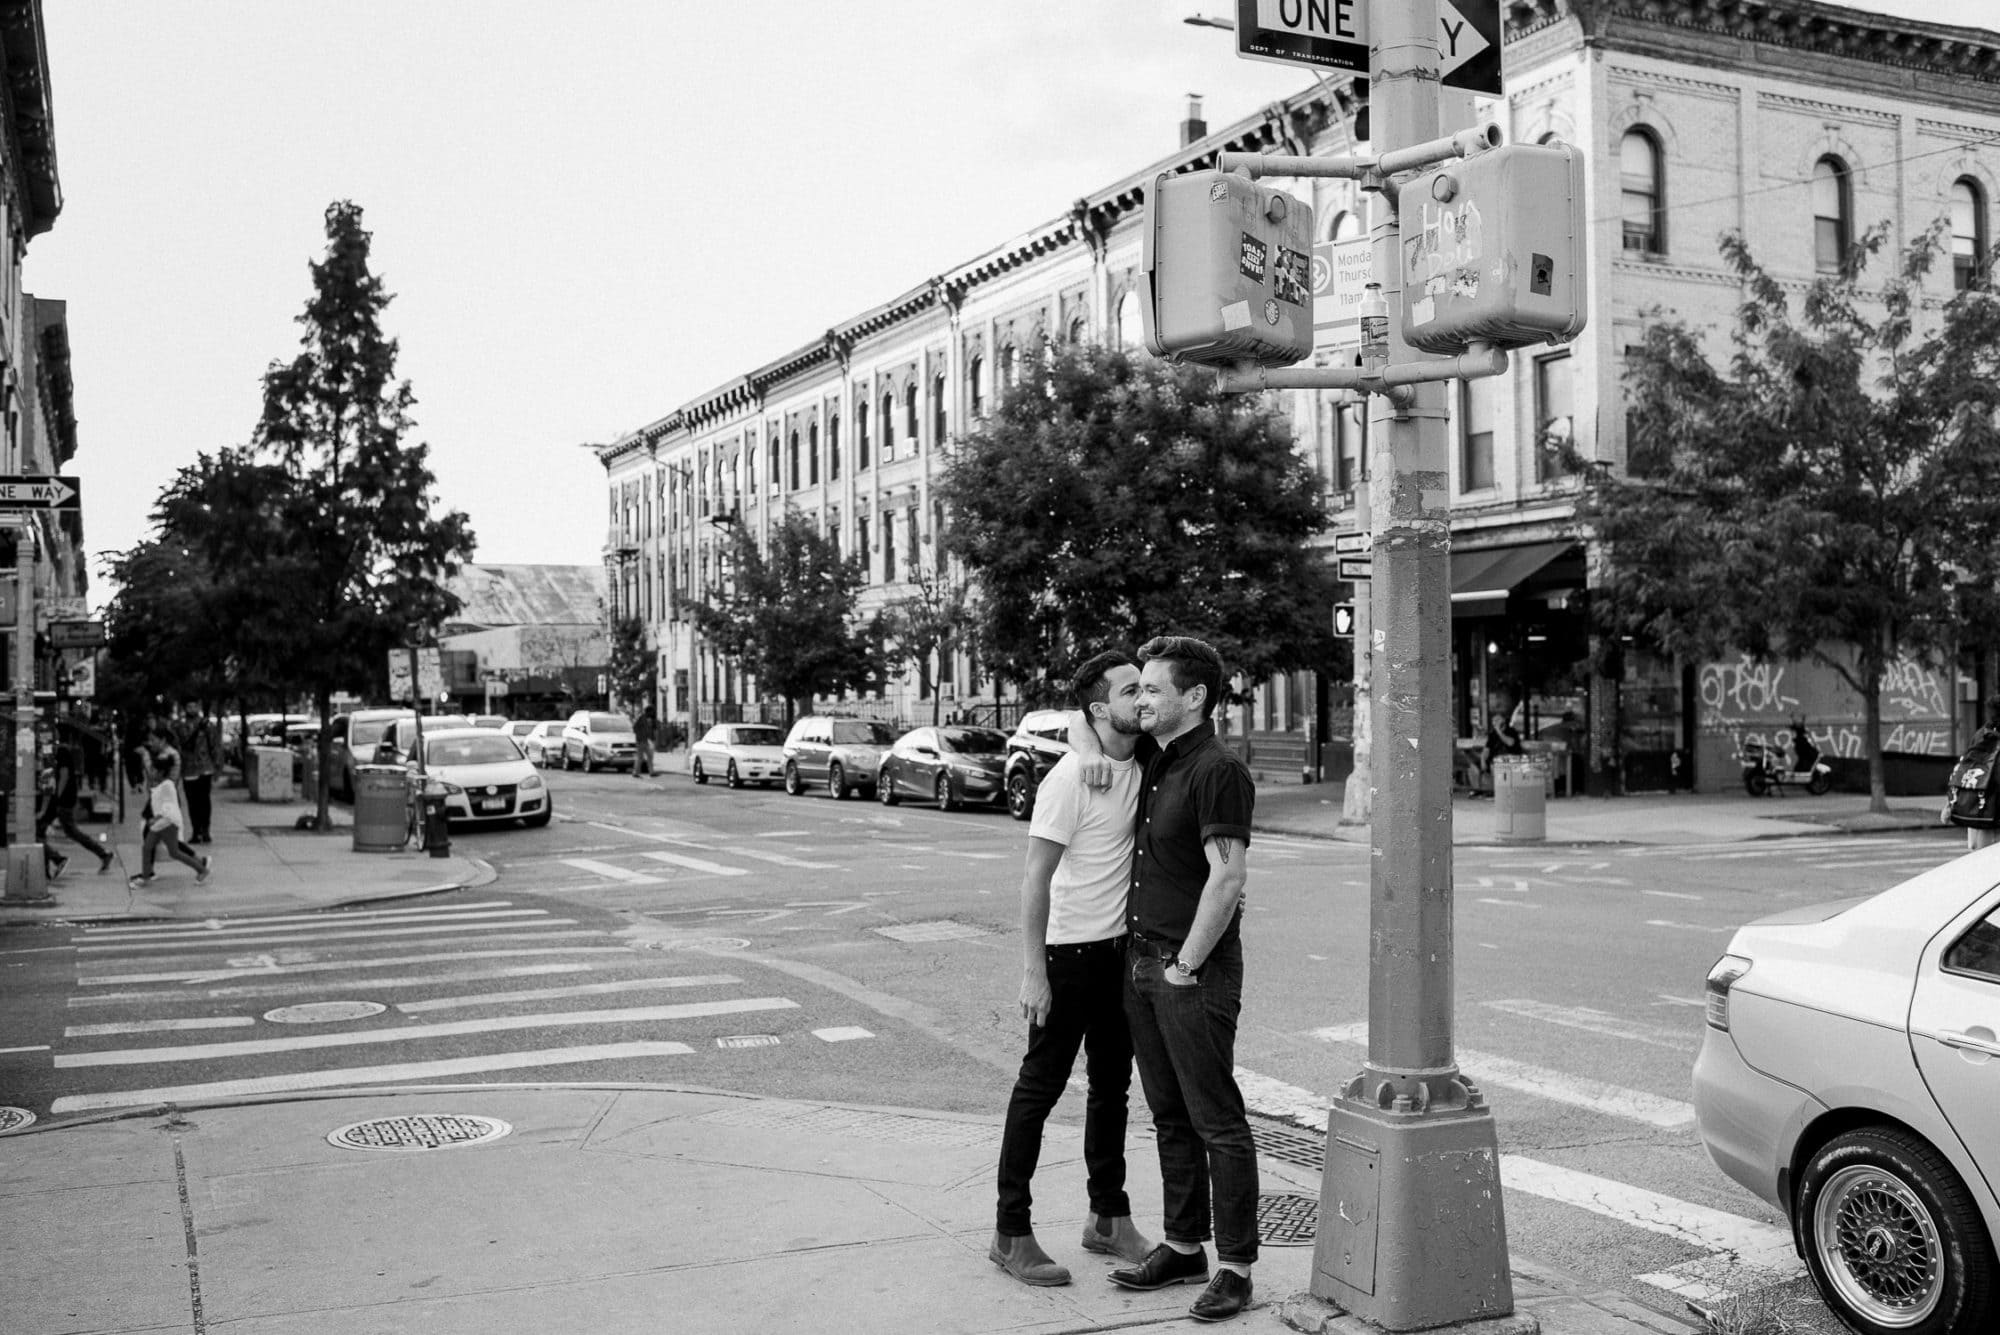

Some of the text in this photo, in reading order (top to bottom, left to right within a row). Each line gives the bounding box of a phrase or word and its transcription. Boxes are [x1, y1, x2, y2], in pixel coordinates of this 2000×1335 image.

[1279, 0, 1356, 38] ONE
[1249, 44, 1269, 53] DEPT
[1338, 250, 1372, 266] Monda
[1339, 268, 1371, 282] Thurs
[0, 486, 64, 499] NE WAY
